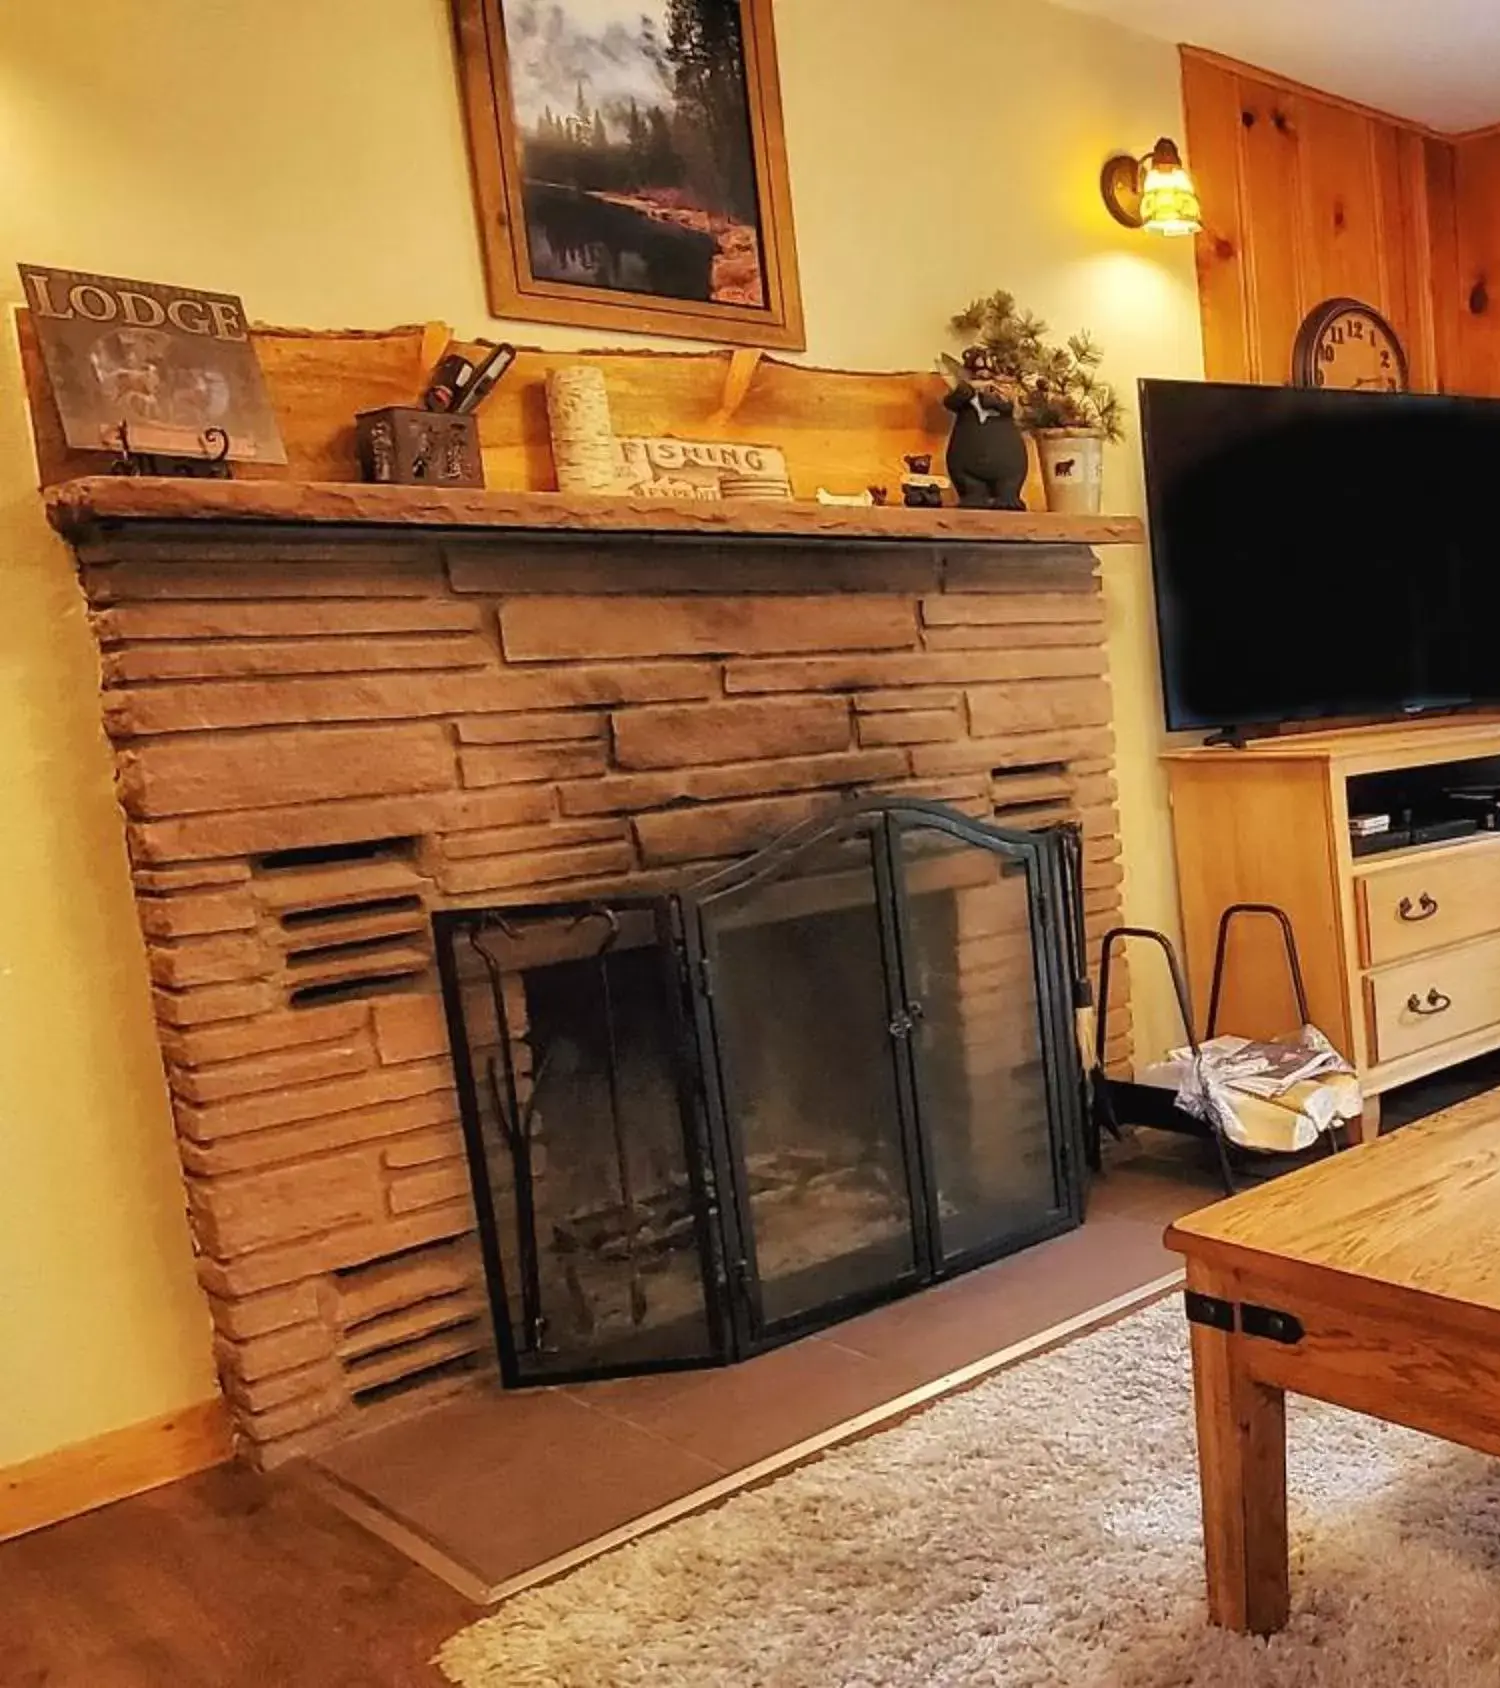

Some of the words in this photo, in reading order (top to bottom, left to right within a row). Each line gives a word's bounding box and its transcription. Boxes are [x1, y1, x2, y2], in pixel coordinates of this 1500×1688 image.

[28, 273, 248, 343] LODGE
[1330, 326, 1344, 344] 11
[1346, 320, 1363, 340] 12
[1380, 350, 1390, 368] 2
[620, 441, 764, 472] FISHING
